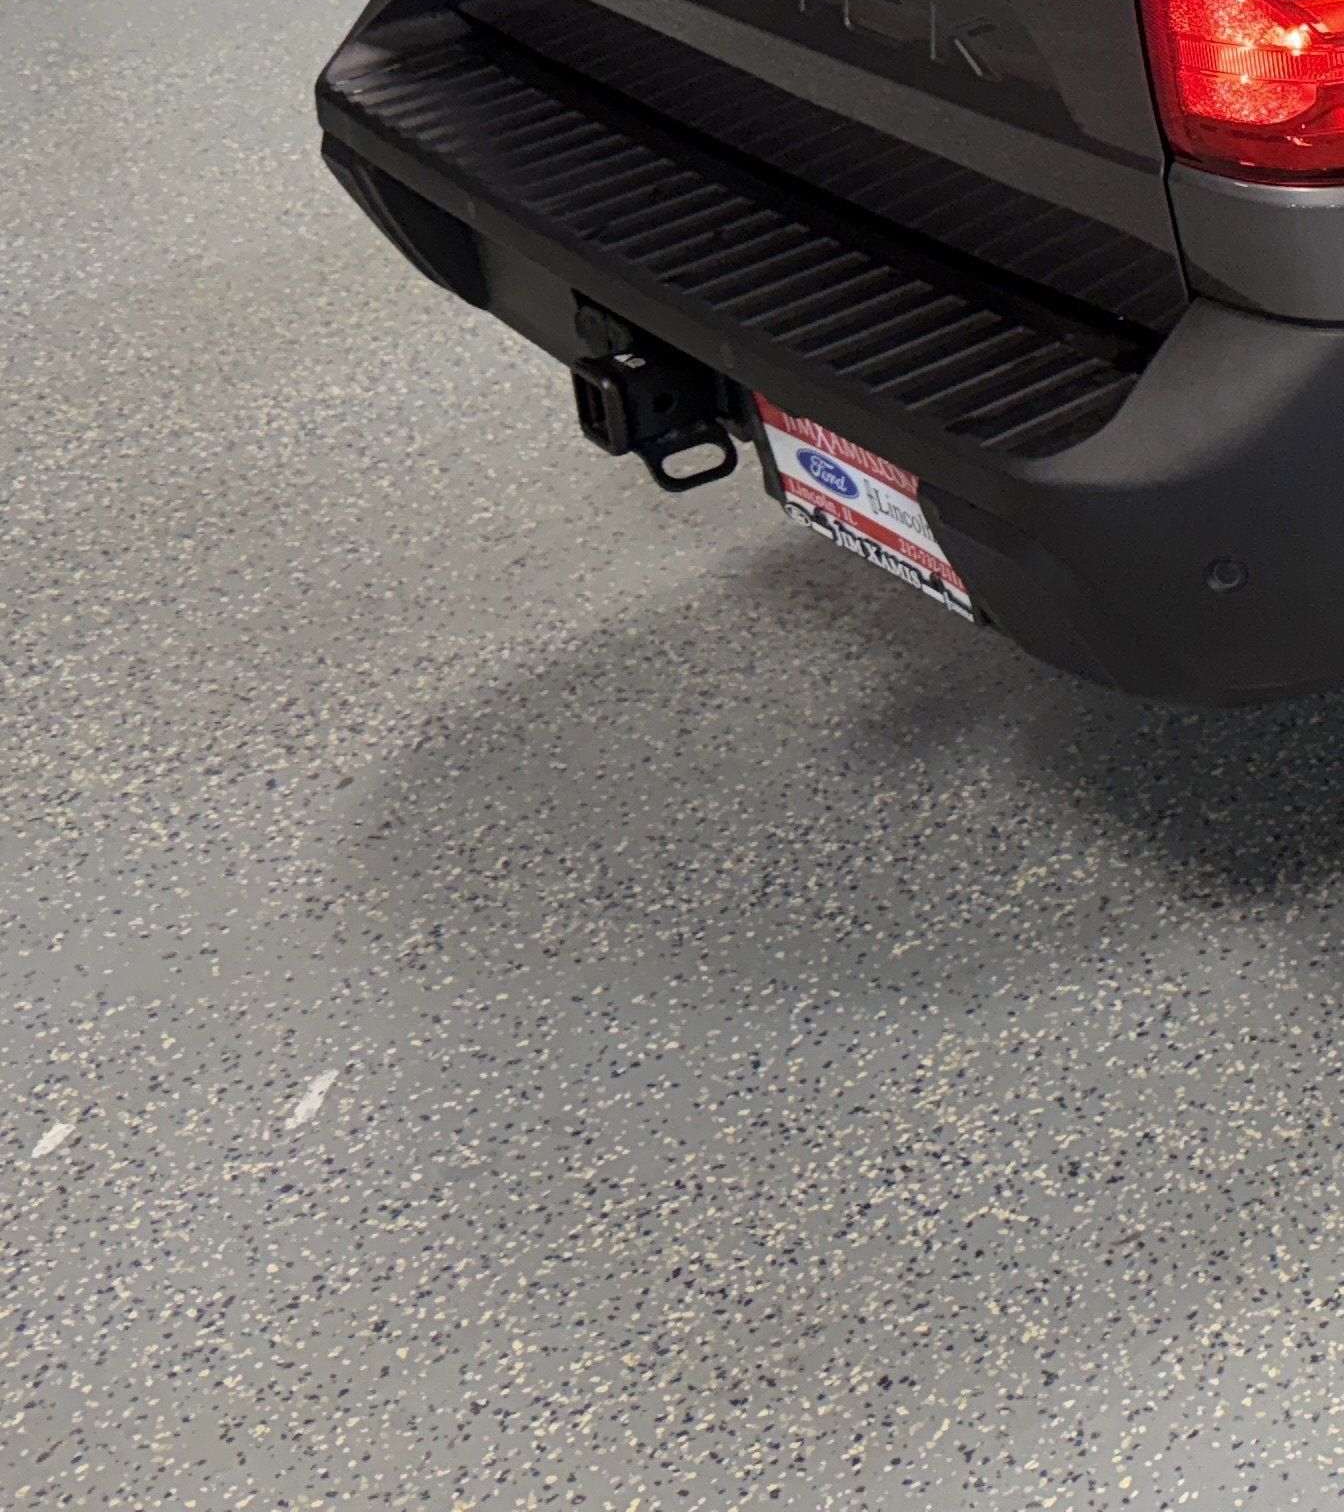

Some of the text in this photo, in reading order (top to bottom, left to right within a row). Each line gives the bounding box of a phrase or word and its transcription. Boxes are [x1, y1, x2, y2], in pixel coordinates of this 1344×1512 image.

[810, 455, 848, 493] Ford
[834, 524, 923, 589] JIM XAMIS
